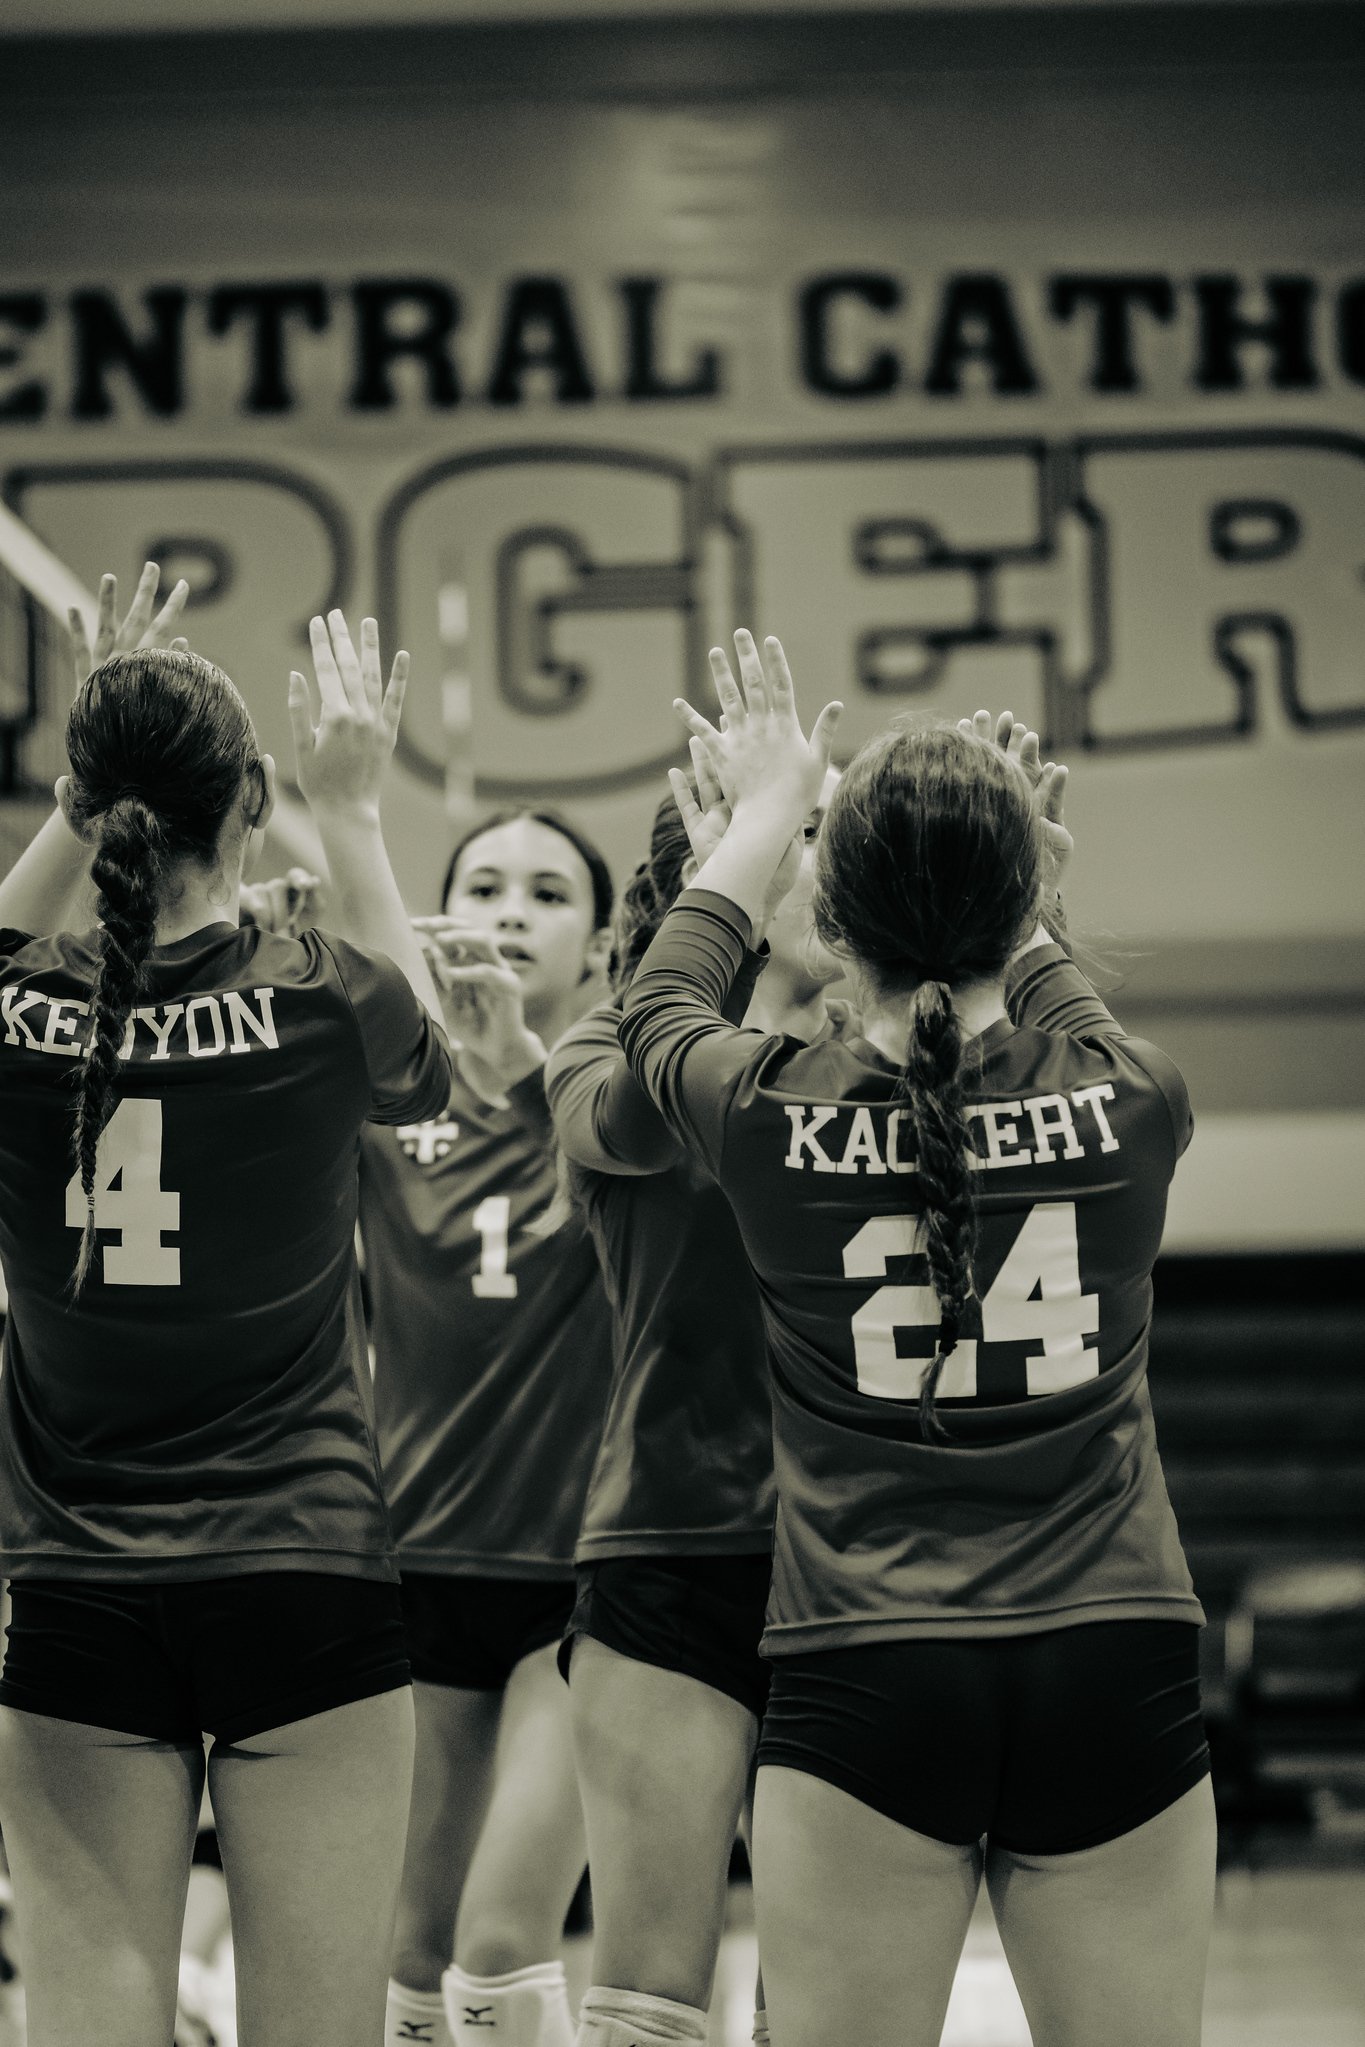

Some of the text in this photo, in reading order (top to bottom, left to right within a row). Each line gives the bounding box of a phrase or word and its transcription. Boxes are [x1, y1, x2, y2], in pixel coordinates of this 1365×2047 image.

[798, 271, 1365, 397] CATH
[0, 426, 1365, 803] RGER
[65, 1098, 181, 1286] 4
[472, 1196, 518, 1298] 1
[842, 1202, 1100, 1400] 24
